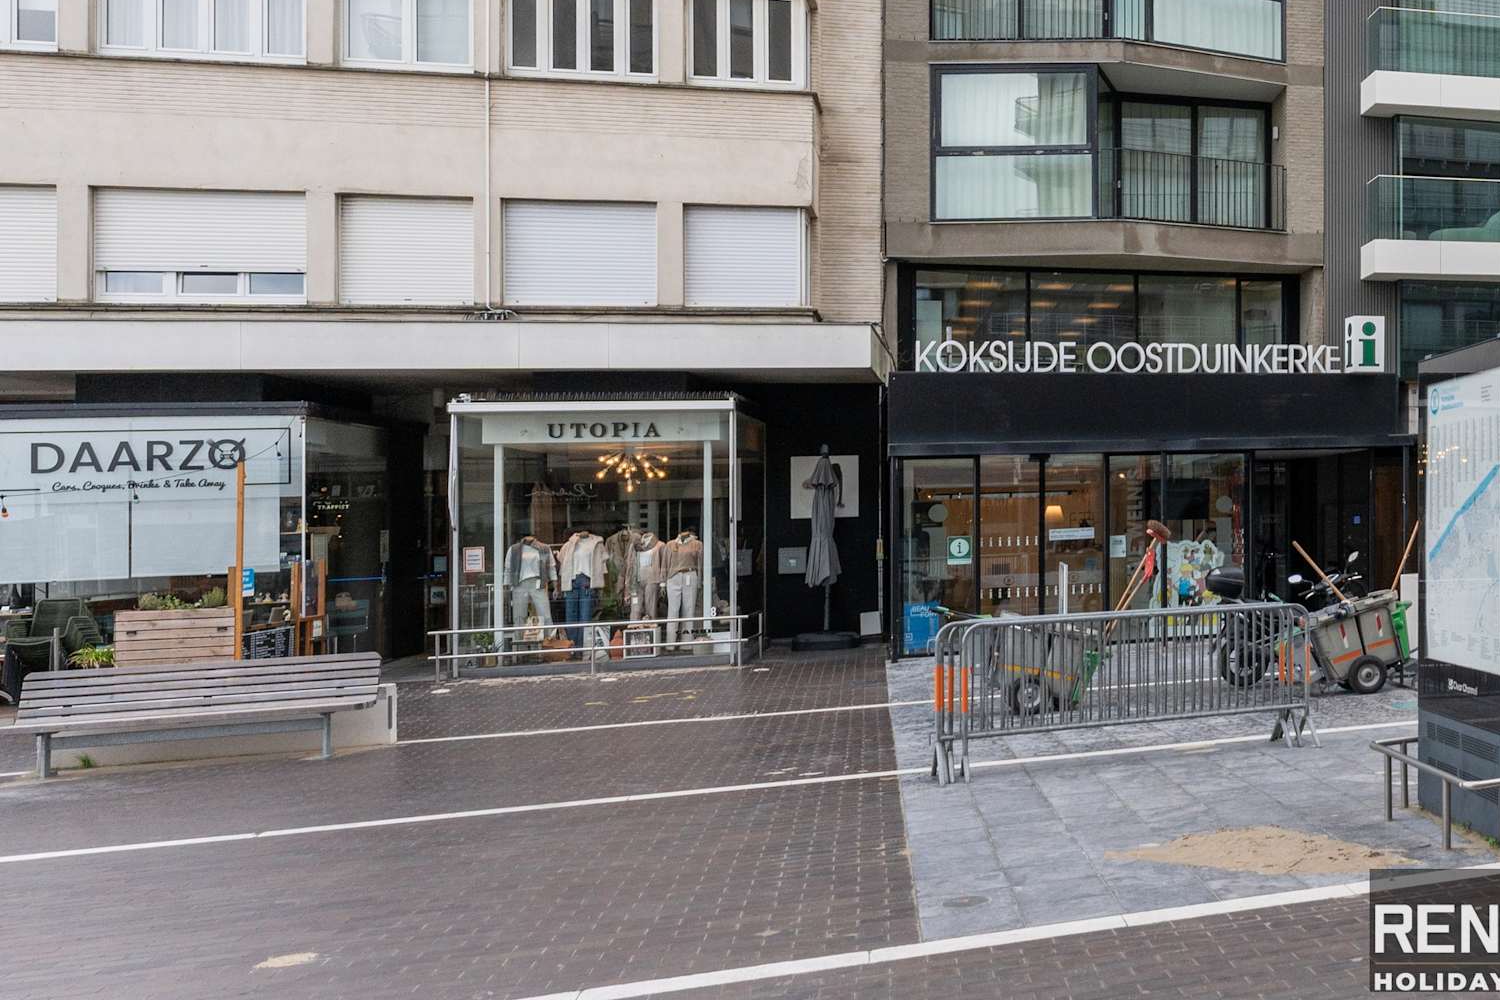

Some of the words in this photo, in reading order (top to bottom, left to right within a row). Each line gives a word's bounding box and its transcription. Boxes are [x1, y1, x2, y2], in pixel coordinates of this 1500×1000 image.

[914, 339, 1076, 373] KOKSIJDE
[1087, 341, 1341, 374] OOSTDUINKERKE
[547, 422, 662, 438] UTOPIA
[30, 438, 246, 474] DAARZO
